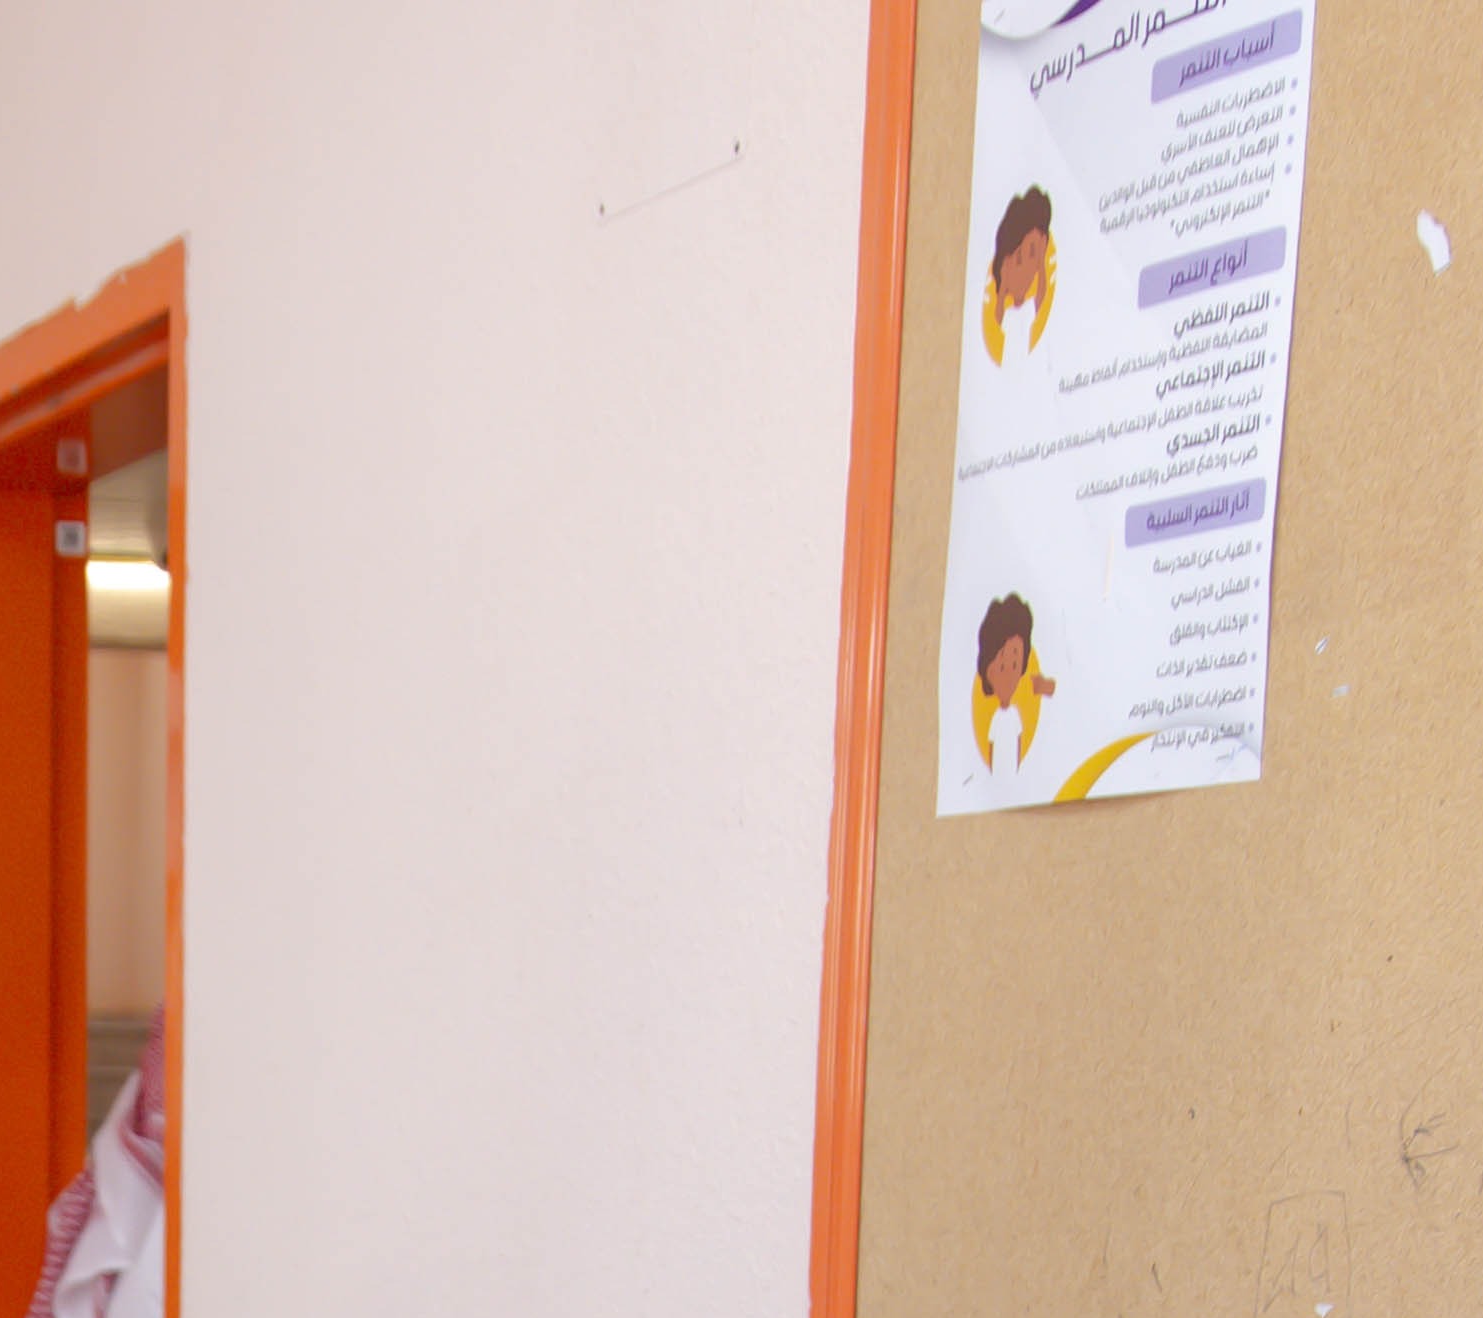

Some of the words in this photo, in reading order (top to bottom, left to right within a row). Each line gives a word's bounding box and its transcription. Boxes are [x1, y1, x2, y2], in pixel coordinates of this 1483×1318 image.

[1223, 21, 1276, 67] أسباب
[1178, 47, 1221, 89] التنمر
[1176, 98, 1221, 130] النفسية
[1157, 169, 1176, 192] من
[1168, 257, 1209, 296] التنمر
[1209, 239, 1248, 287] أنواع
[1173, 301, 1228, 341] اللفظي
[1229, 290, 1270, 326] التنمر
[1225, 349, 1266, 384] التنمر
[1166, 422, 1220, 459] الجسدي
[1221, 412, 1261, 446] التنمر
[1160, 457, 1196, 485] الطفل
[1229, 444, 1258, 467] ضرب
[1146, 503, 1193, 532] السلبية
[1193, 495, 1229, 527] التنمر
[1153, 551, 1197, 577] المدرسة
[1198, 549, 1214, 569] عن
[1214, 575, 1251, 602] الفشل
[1155, 658, 1186, 679] الذات
[1213, 650, 1248, 670] ضعف
[1187, 725, 1210, 750] في
